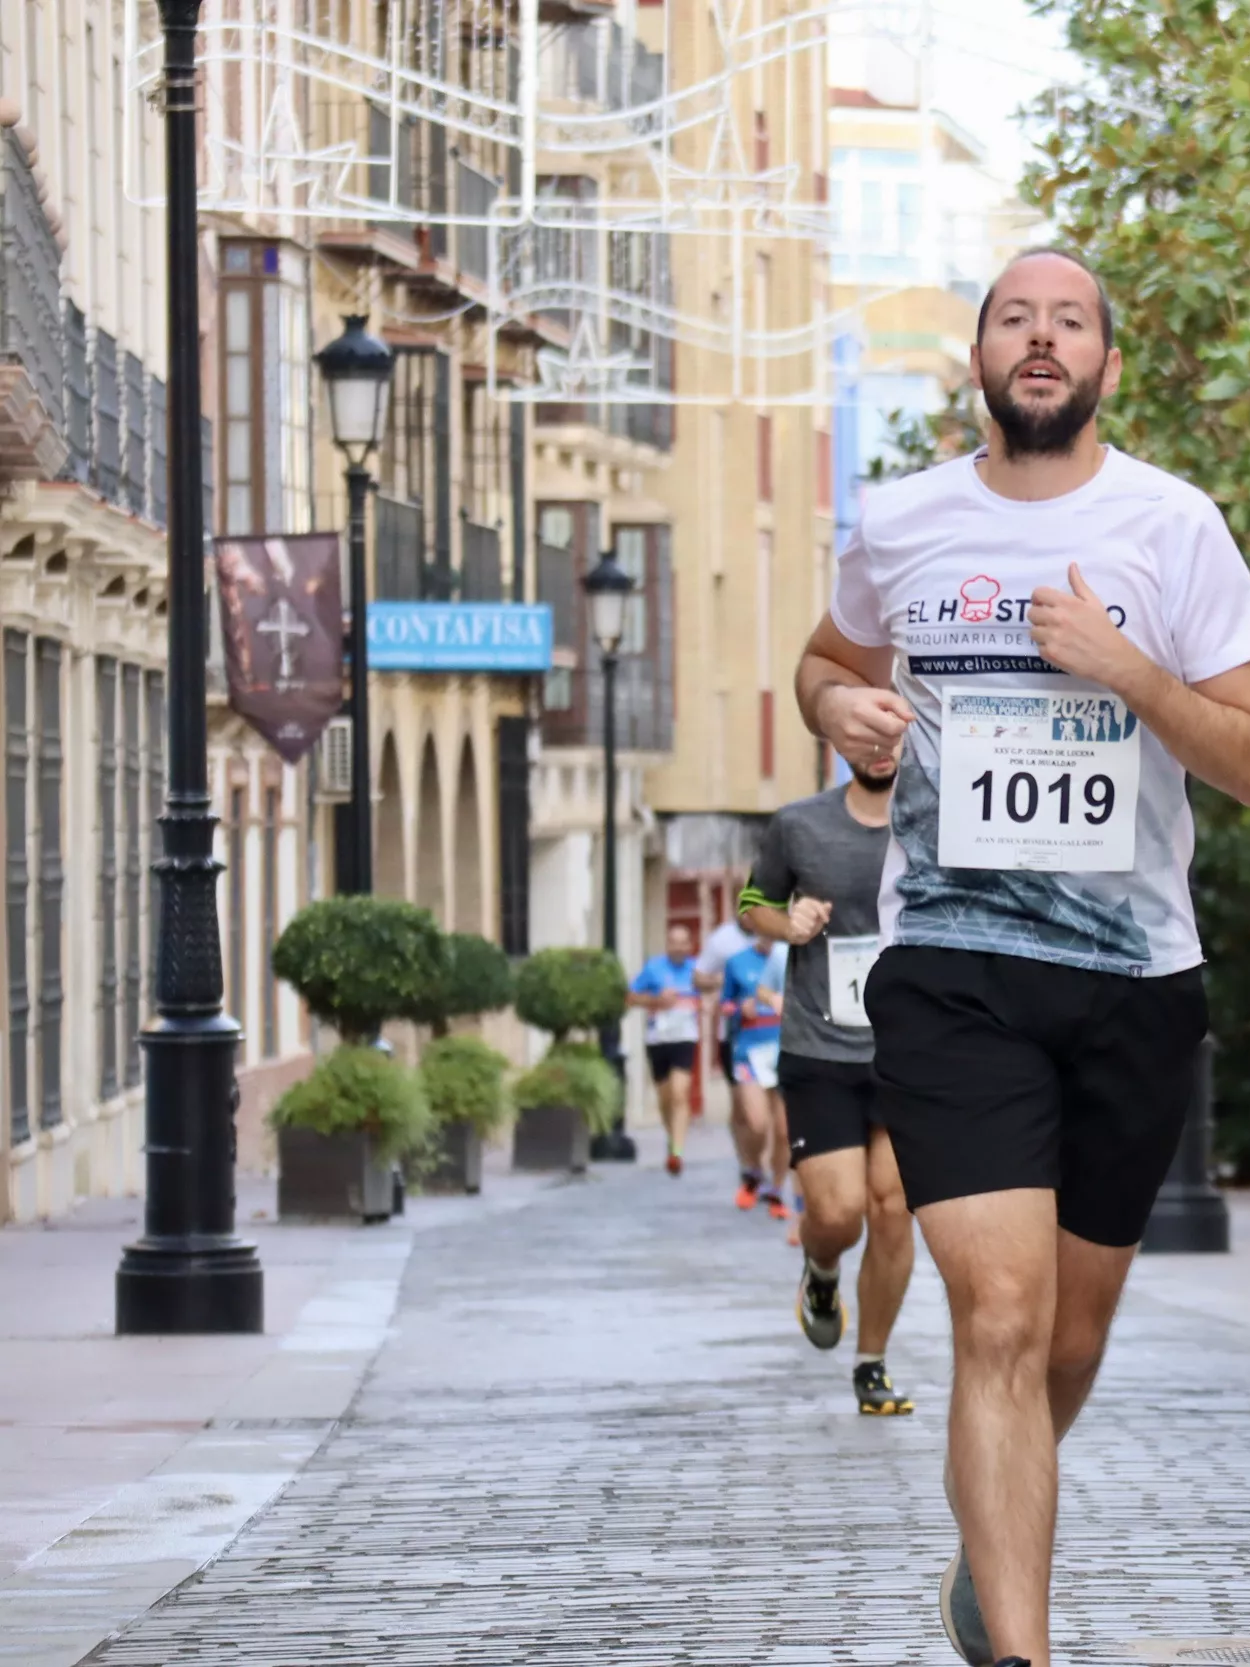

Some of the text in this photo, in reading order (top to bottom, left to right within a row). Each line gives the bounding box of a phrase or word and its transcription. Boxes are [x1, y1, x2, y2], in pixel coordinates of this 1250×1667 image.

[907, 600, 930, 624] EL
[367, 613, 543, 646] CONTAFISA
[906, 632, 997, 646] MAQUINARIA
[1004, 632, 1023, 646] DE
[1052, 699, 1101, 720] 2024
[1055, 749, 1065, 757] DE
[971, 770, 1116, 826] 1019
